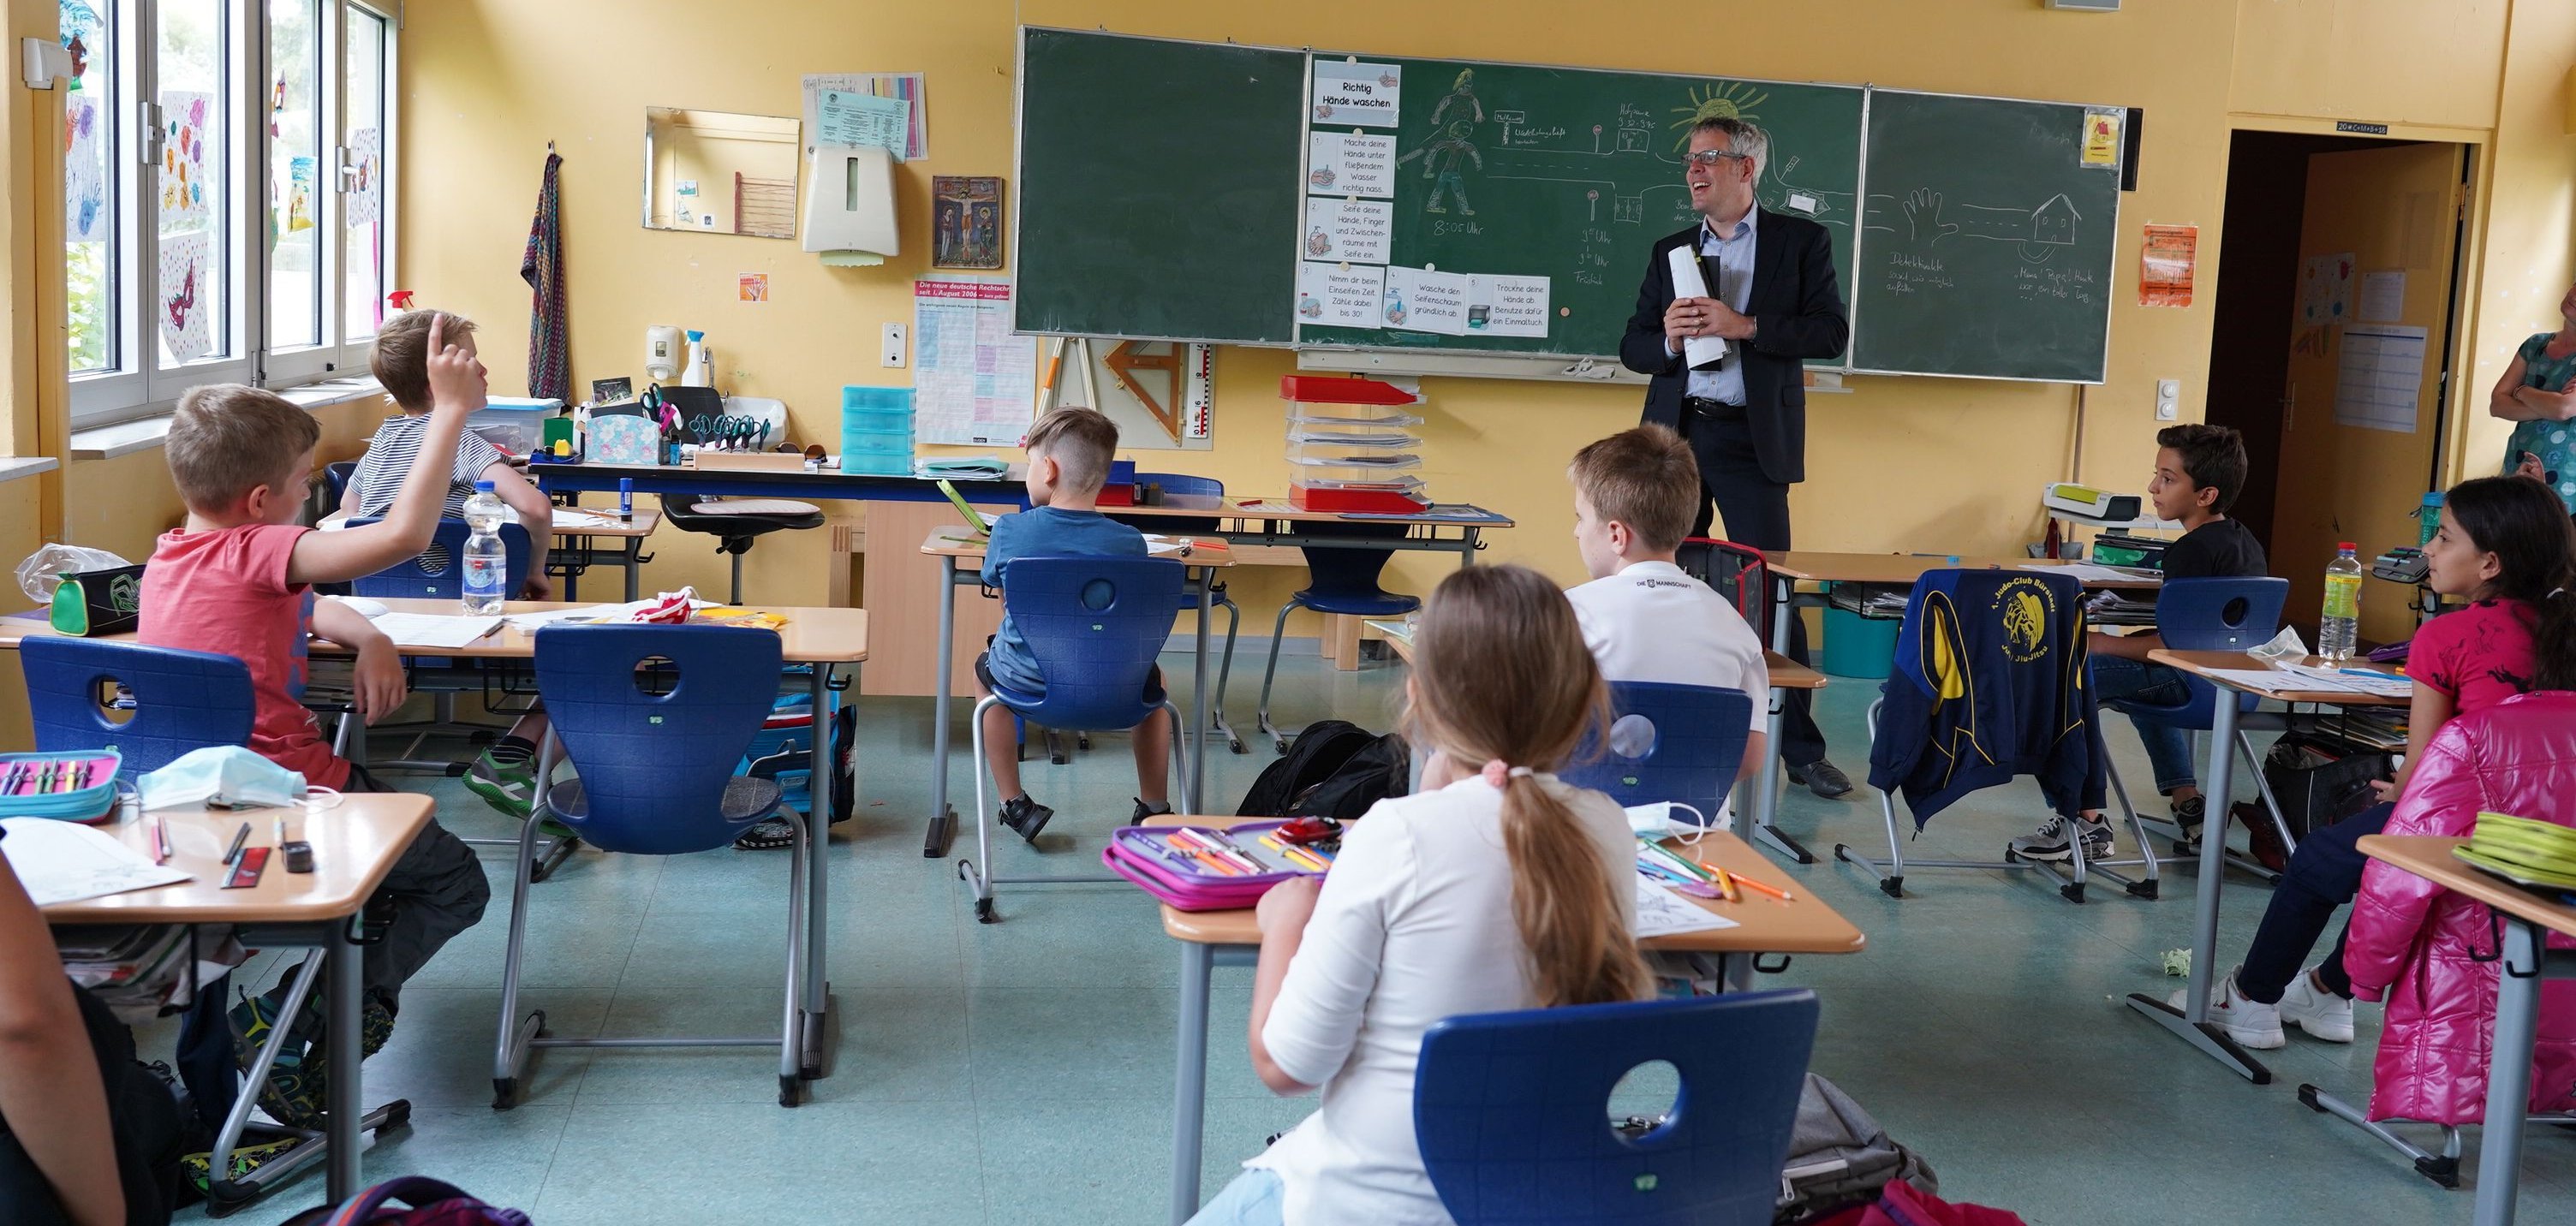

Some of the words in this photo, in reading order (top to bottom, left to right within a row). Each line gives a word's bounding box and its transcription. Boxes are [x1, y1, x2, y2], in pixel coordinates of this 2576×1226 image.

[1343, 82, 1372, 95] Richtig
[1322, 95, 1350, 105] Hände
[1352, 98, 1391, 108] waschen
[1368, 140, 1387, 148] deine
[1345, 161, 1384, 170] fließendem
[1342, 184, 1364, 193] richtig
[1343, 205, 1361, 213] Seife
[1363, 217, 1385, 227] Finger
[1351, 228, 1386, 236] Zwischen-
[1466, 221, 1484, 235] Uhr
[1595, 229, 1612, 244] Uhr
[1344, 249, 1362, 258] Seife
[1595, 253, 1610, 267] Uhr
[1328, 286, 1361, 295] Einseifen
[1418, 283, 1446, 293] Wasche
[1447, 287, 1461, 295] den
[1496, 283, 1524, 292] Trockne
[1414, 295, 1462, 306] Seifenschaum
[1415, 306, 1447, 316] gründlich
[1494, 306, 1524, 314] Benutze
[1656, 580, 1691, 589] MANNSCHAFT
[1994, 576, 2033, 599] Judo-Club
[2033, 579, 2055, 613] Bürstadt
[1991, 601, 2000, 610] 1.
[2015, 645, 2048, 663] Jiu-Jitsu
